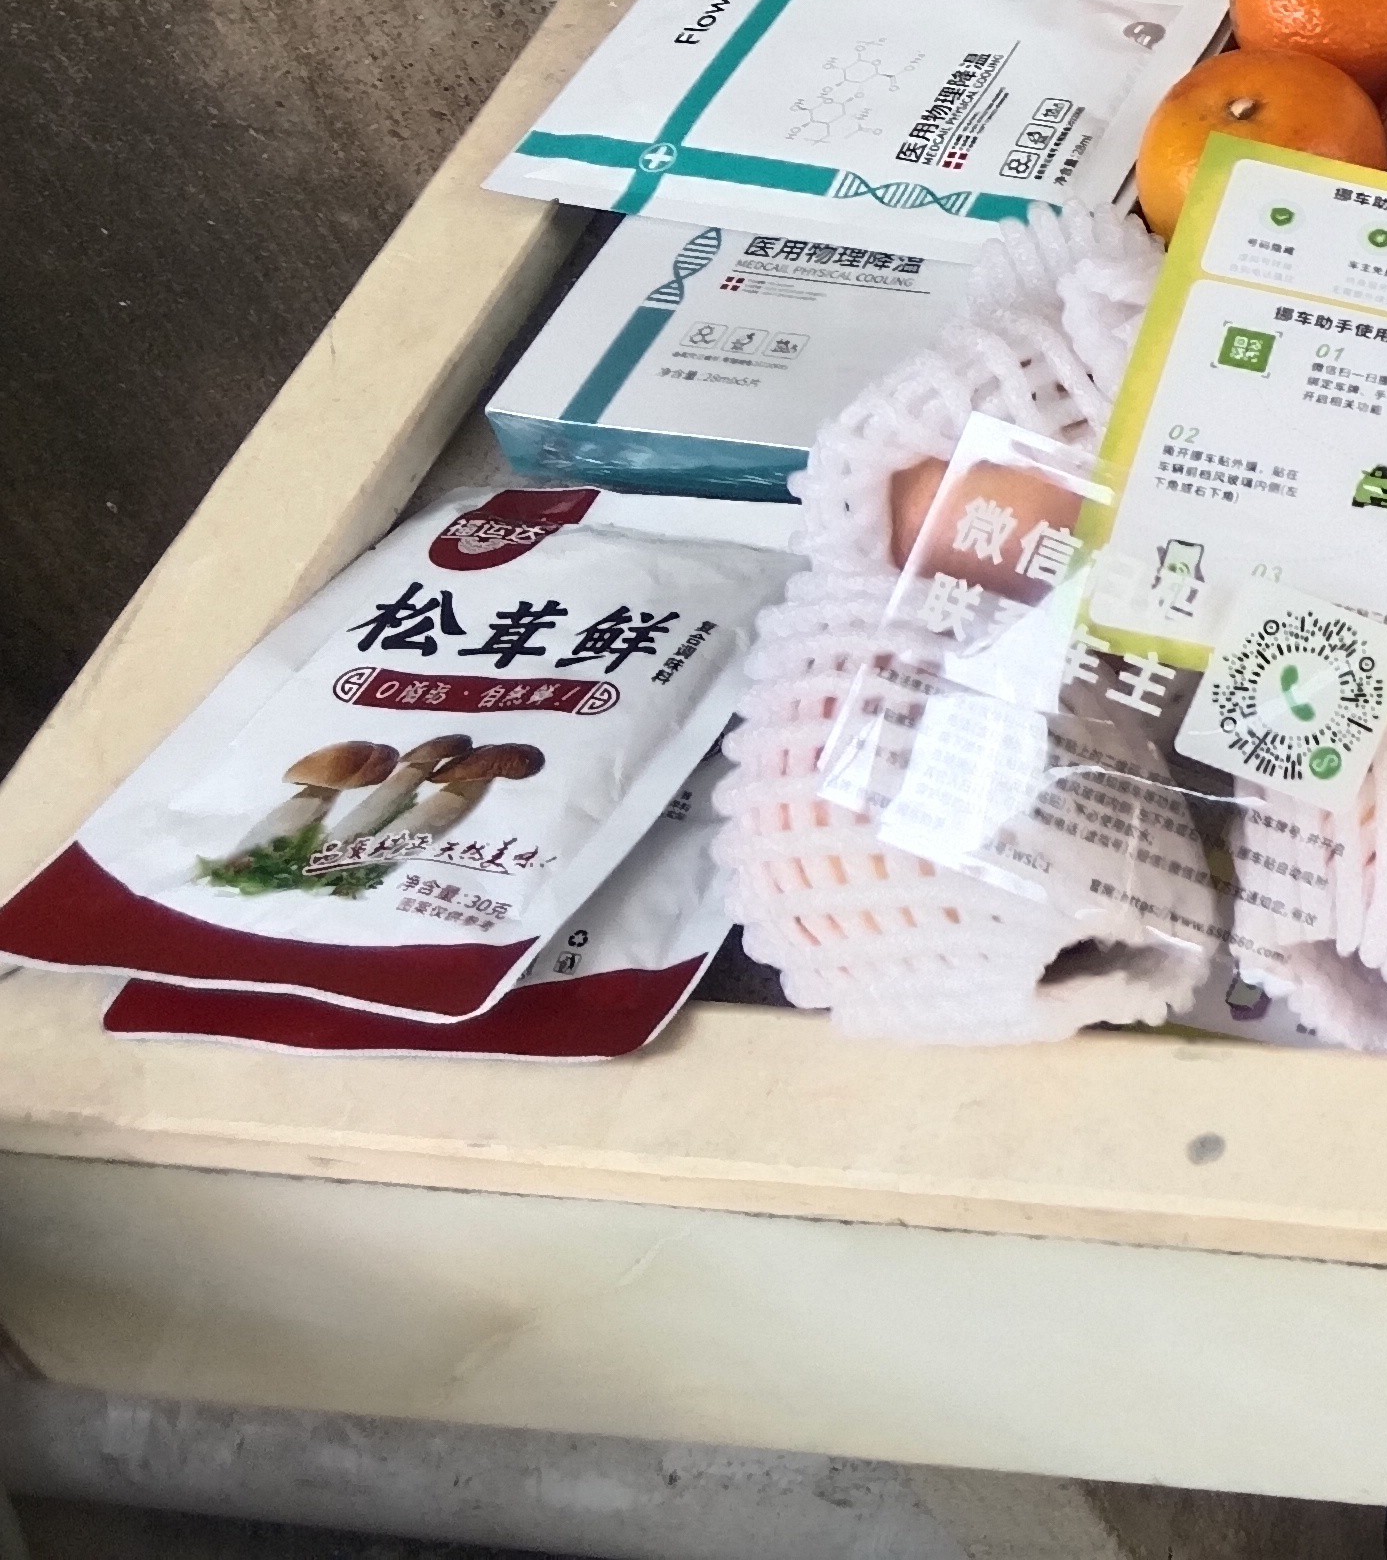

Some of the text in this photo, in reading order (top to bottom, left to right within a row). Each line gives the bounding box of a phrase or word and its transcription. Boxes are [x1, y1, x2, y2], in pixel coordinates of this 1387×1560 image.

[895, 52, 992, 163] 医用物理降温
[743, 235, 926, 275] 医用物理降温
[1314, 342, 1346, 363] 01
[1168, 423, 1201, 444] 02
[344, 580, 682, 675] 松茸鲜
